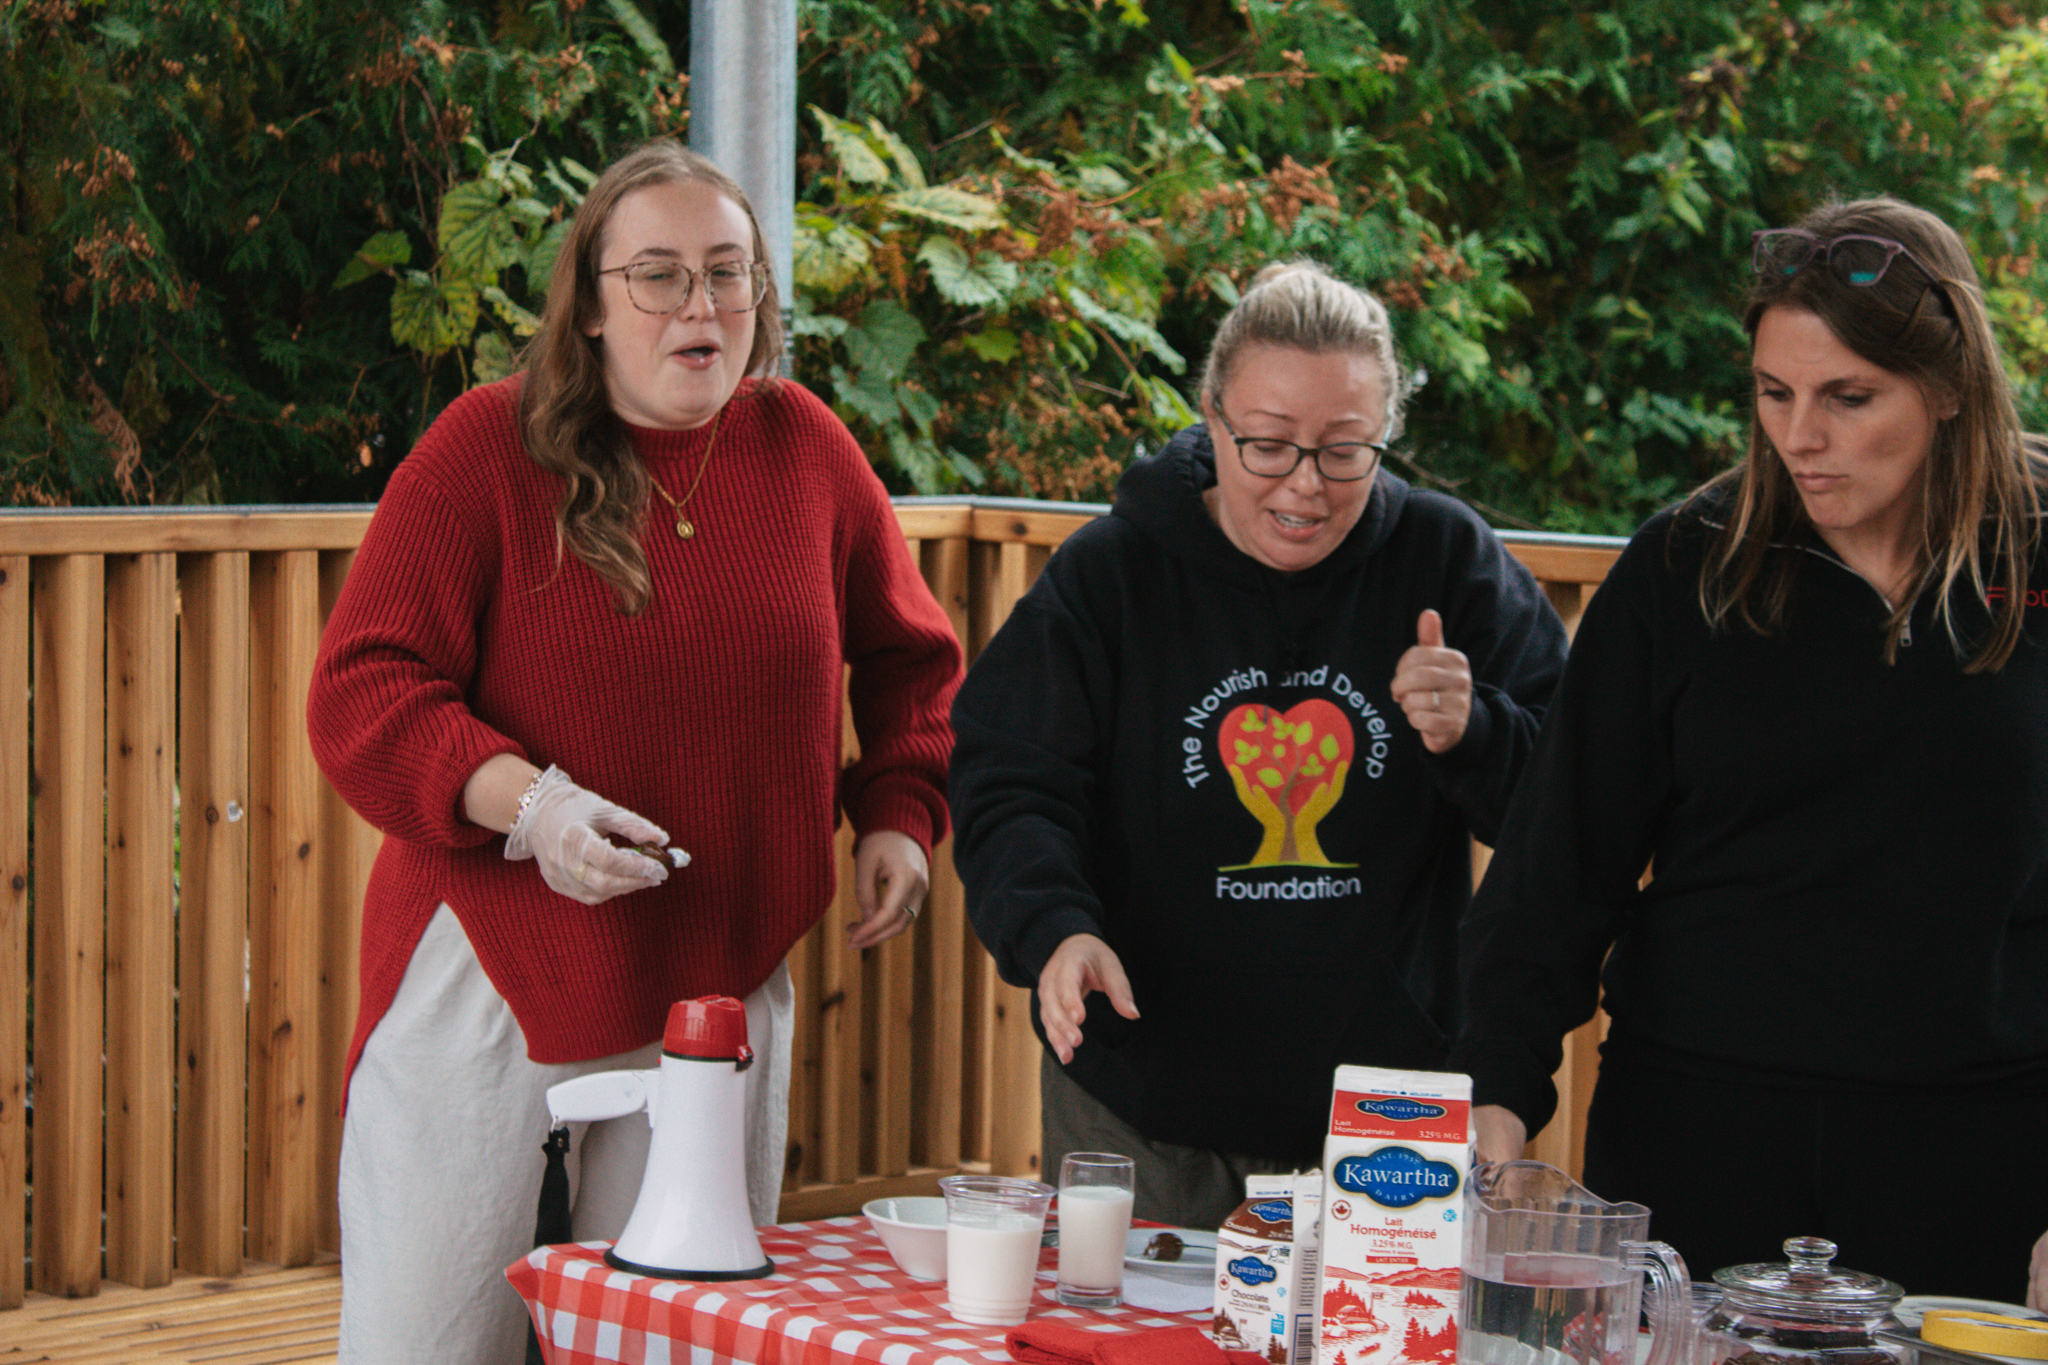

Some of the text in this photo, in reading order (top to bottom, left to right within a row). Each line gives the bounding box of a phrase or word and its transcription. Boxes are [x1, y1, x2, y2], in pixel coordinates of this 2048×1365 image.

[1183, 666, 1269, 729] Nourish
[1331, 673, 1393, 779] Develop
[1182, 736, 1210, 788] The
[1215, 875, 1362, 900] Foundation
[1364, 1101, 1439, 1116] Kawartha
[1334, 1119, 1352, 1127] Lait
[1334, 1125, 1396, 1136] Homogénéisé
[1343, 1163, 1449, 1187] Kawartha
[1375, 1189, 1415, 1201] DAIRY
[1384, 1217, 1403, 1226] Lait
[1350, 1223, 1437, 1240] Homogénéisé
[1230, 1263, 1274, 1279] Kawartha
[1231, 1289, 1269, 1303] Chocolate
